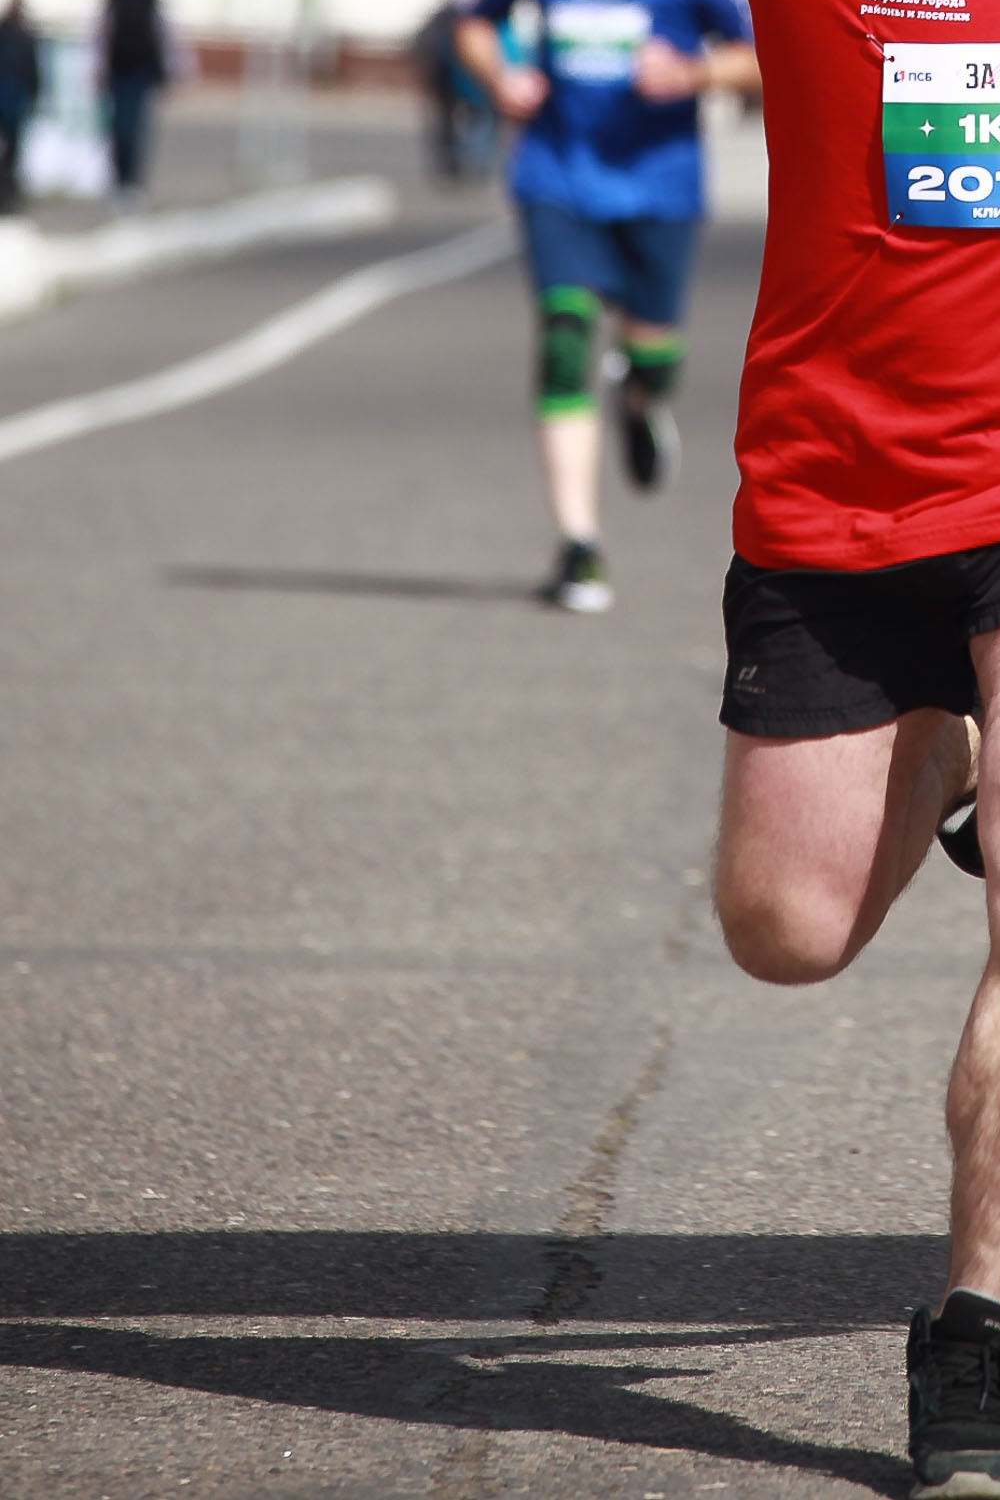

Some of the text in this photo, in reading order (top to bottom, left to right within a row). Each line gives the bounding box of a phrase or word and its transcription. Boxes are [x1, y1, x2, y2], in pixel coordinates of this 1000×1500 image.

[860, 4, 971, 22] районы и поселки
[908, 72, 932, 82] ПСБ
[966, 63, 995, 89] ЗА
